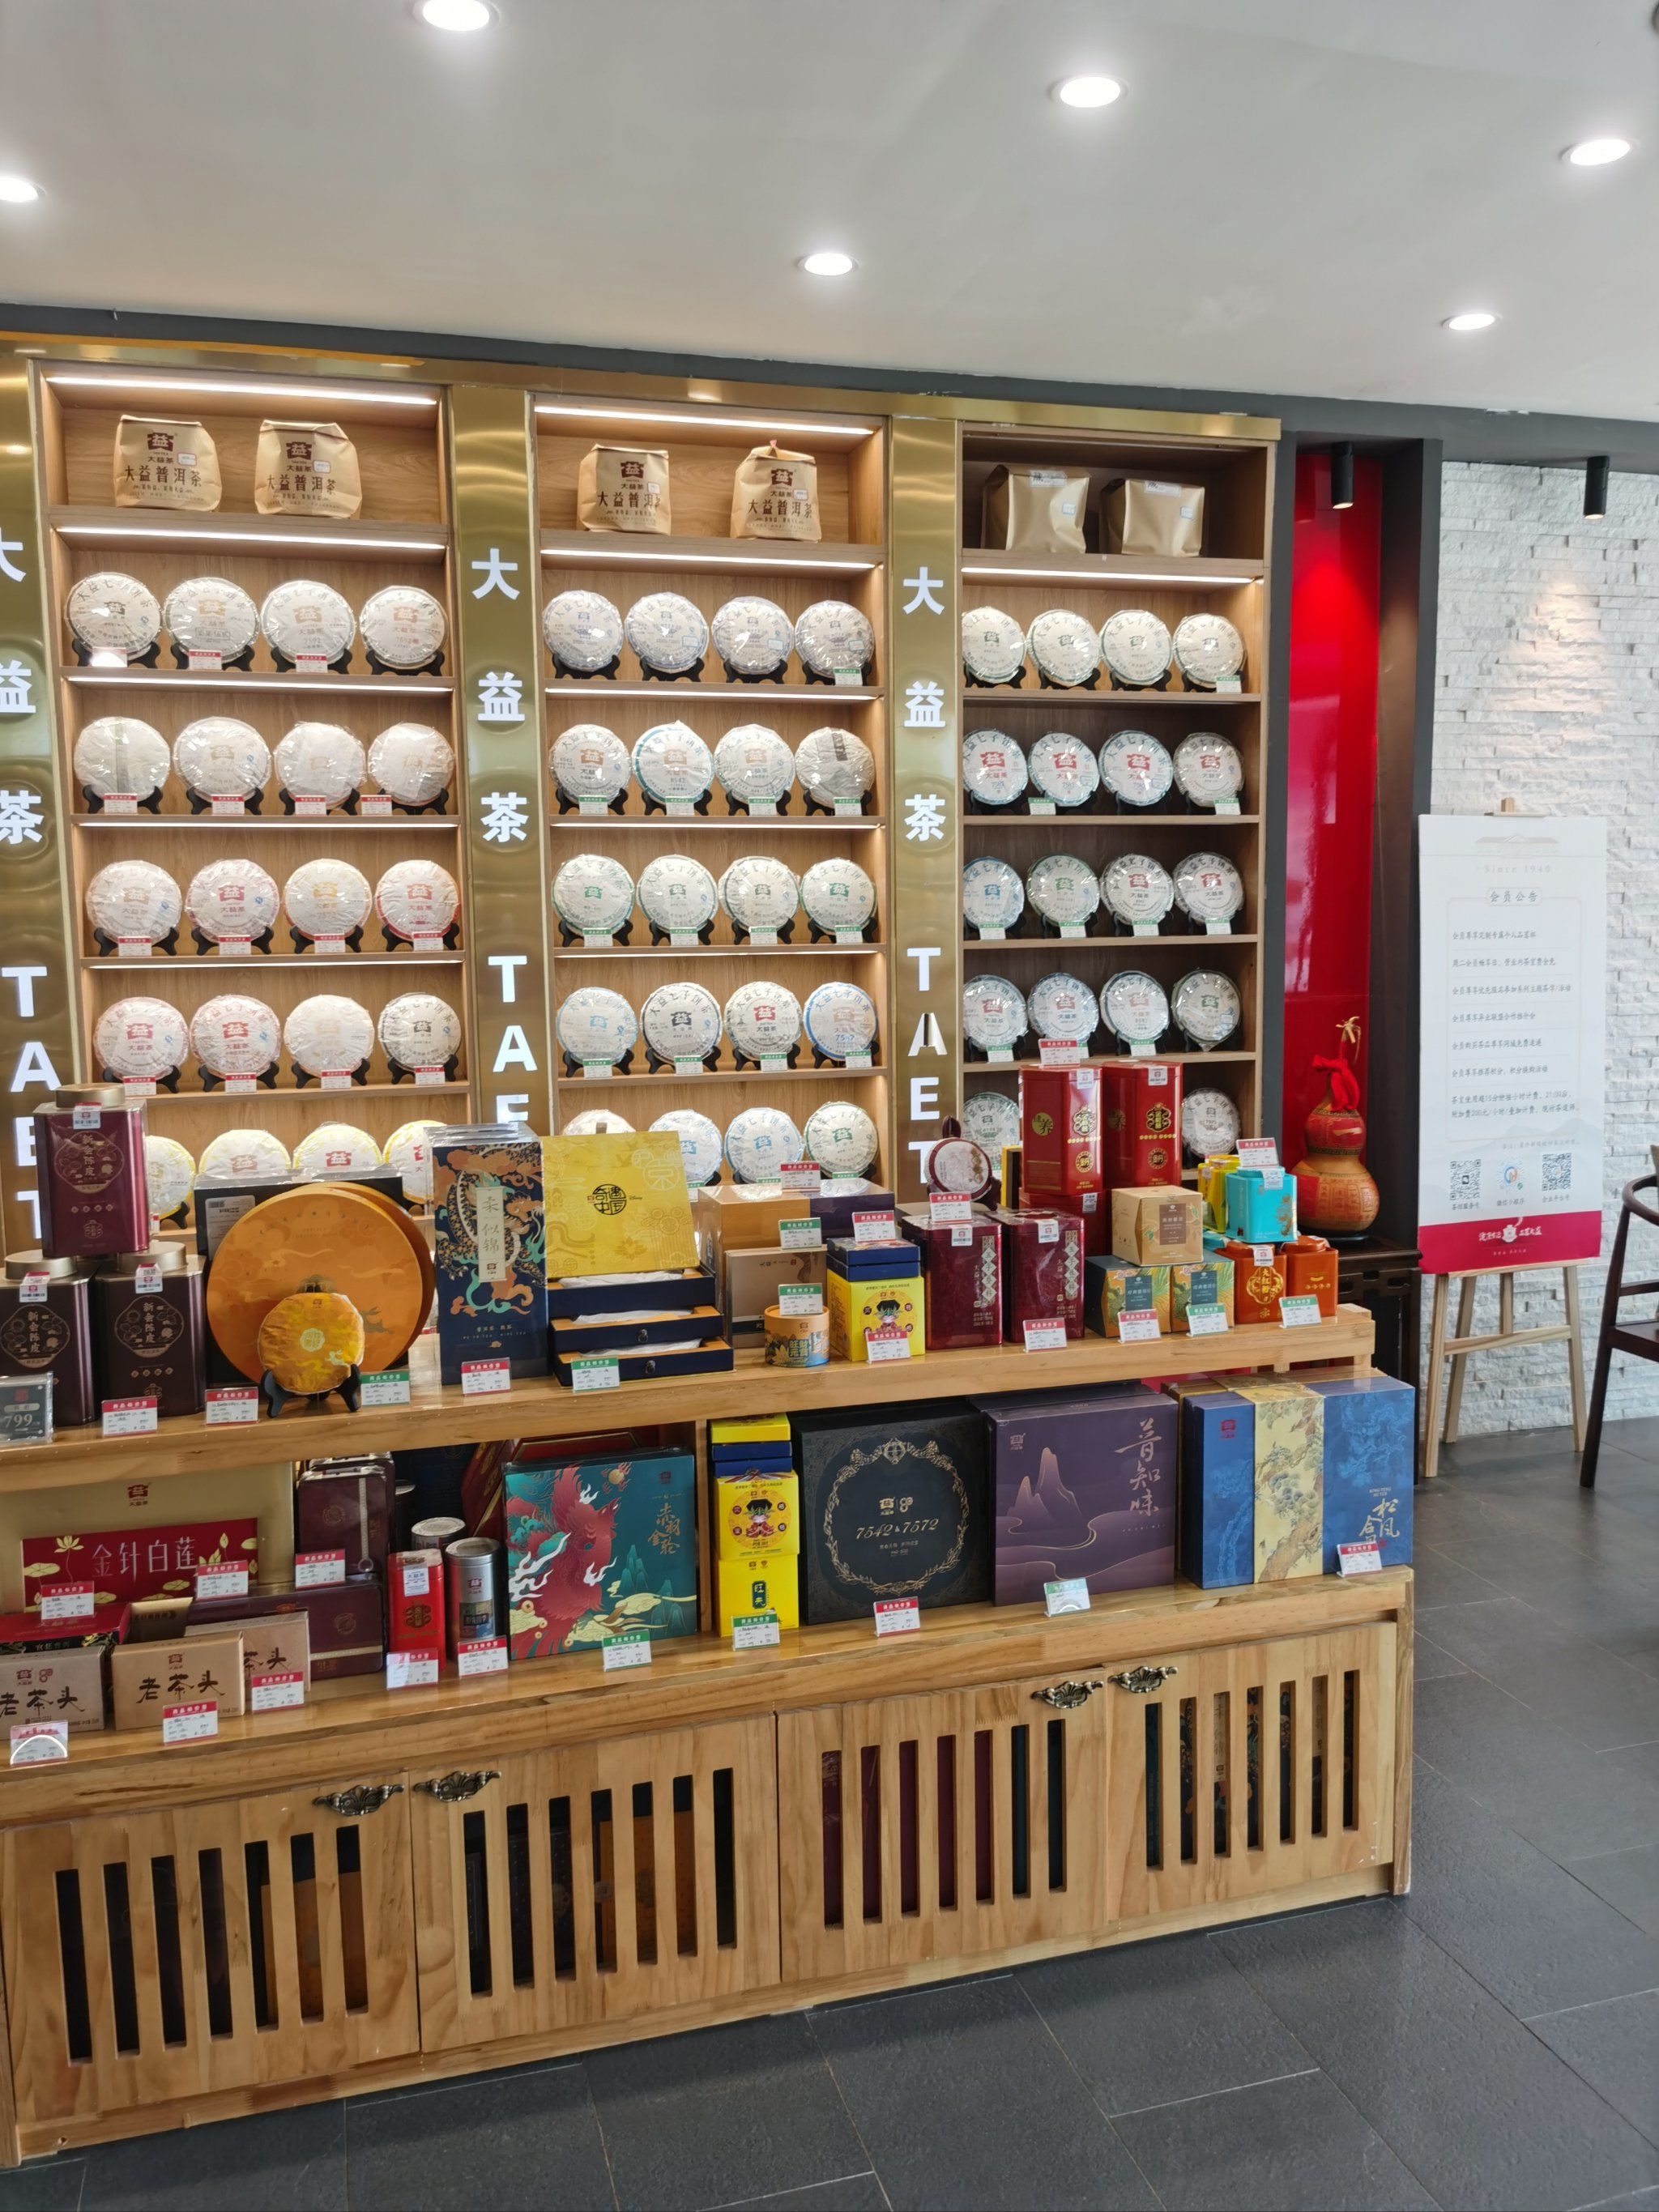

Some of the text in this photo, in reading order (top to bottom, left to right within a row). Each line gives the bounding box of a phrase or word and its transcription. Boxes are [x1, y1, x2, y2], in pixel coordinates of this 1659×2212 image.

[124, 465, 203, 488] 大益普洱茶
[267, 474, 339, 496] 大益普洱茶
[471, 548, 529, 843] 大益茶
[902, 566, 947, 841] 大益茶
[1490, 891, 1538, 903] 会员公告
[82, 1134, 96, 1177] 新会陈皮
[28, 1311, 41, 1354] 新会陈皮
[143, 1302, 156, 1345] 新会陈皮
[855, 1524, 893, 1540] 7542
[902, 1518, 940, 1534] 7572
[92, 1536, 198, 1578] 金针白莲
[0, 1686, 85, 1716] 老茶头
[137, 1670, 226, 1703] 老茶头
